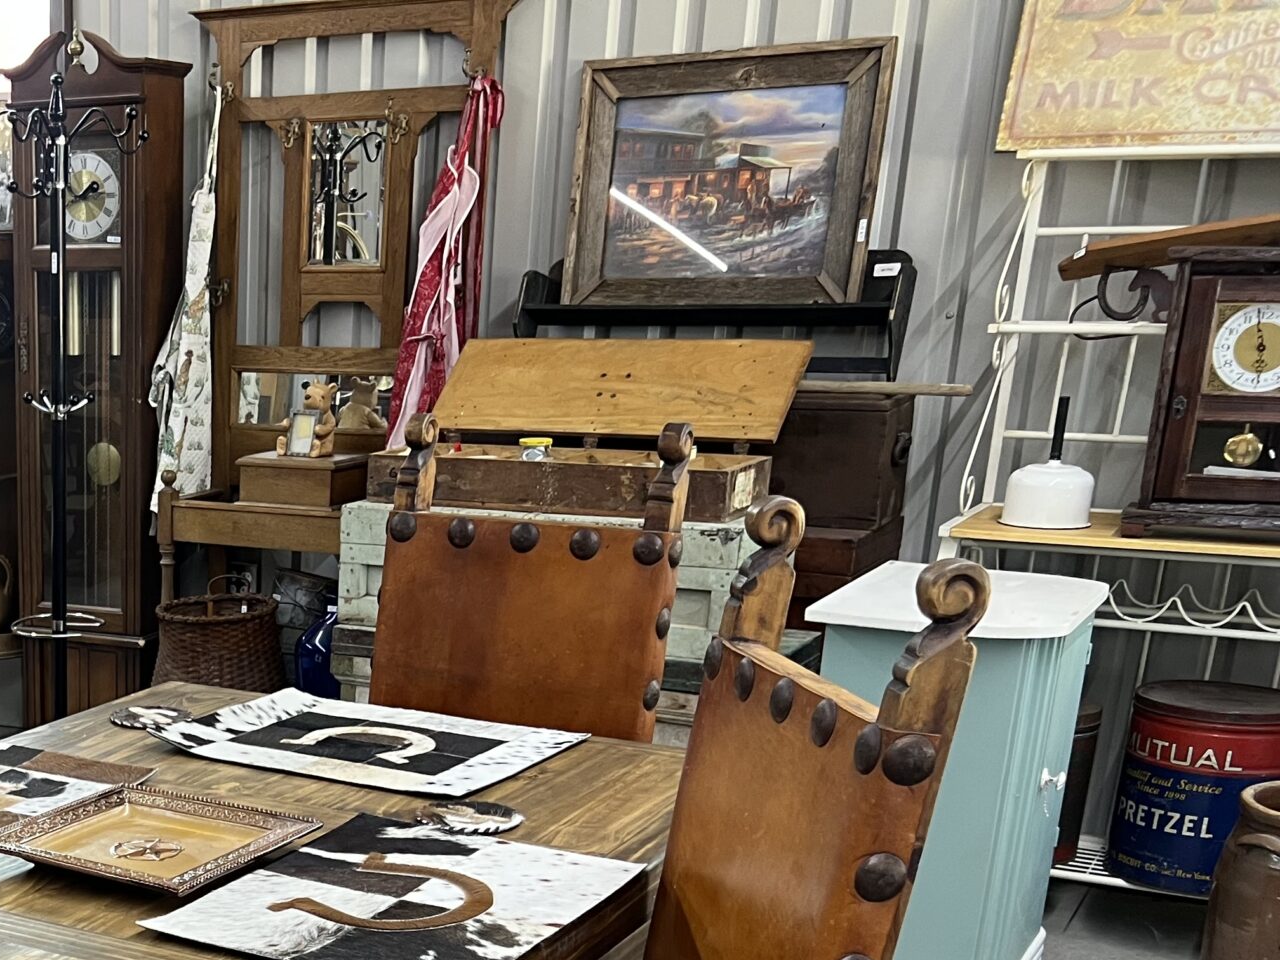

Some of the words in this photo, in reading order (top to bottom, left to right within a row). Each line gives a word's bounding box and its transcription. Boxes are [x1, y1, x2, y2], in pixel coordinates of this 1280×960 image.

[1035, 75, 1168, 112] MILK
[1151, 777, 1174, 788] and
[1177, 778, 1223, 795] Service
[1117, 795, 1214, 839] PRETZEL
